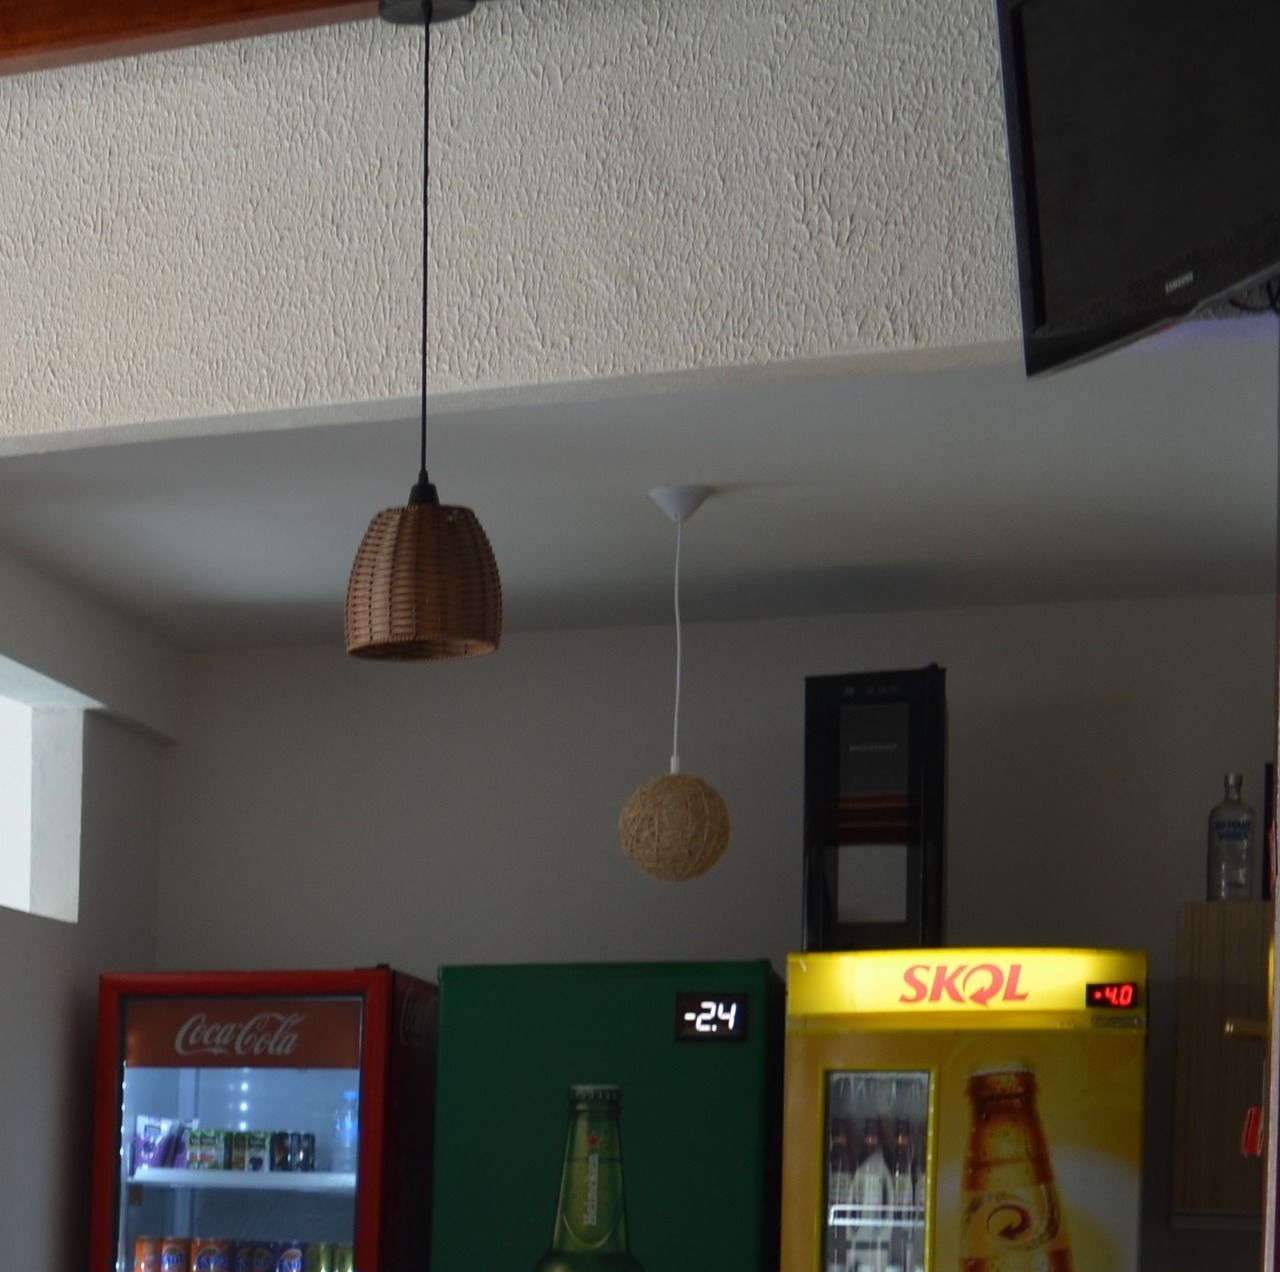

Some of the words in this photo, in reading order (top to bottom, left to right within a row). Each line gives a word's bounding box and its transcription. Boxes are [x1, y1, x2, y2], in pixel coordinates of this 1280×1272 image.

[899, 963, 1030, 1007] SKOL
[174, 1010, 307, 1056] Coca-Cola
[683, 1001, 737, 1032] -2.4
